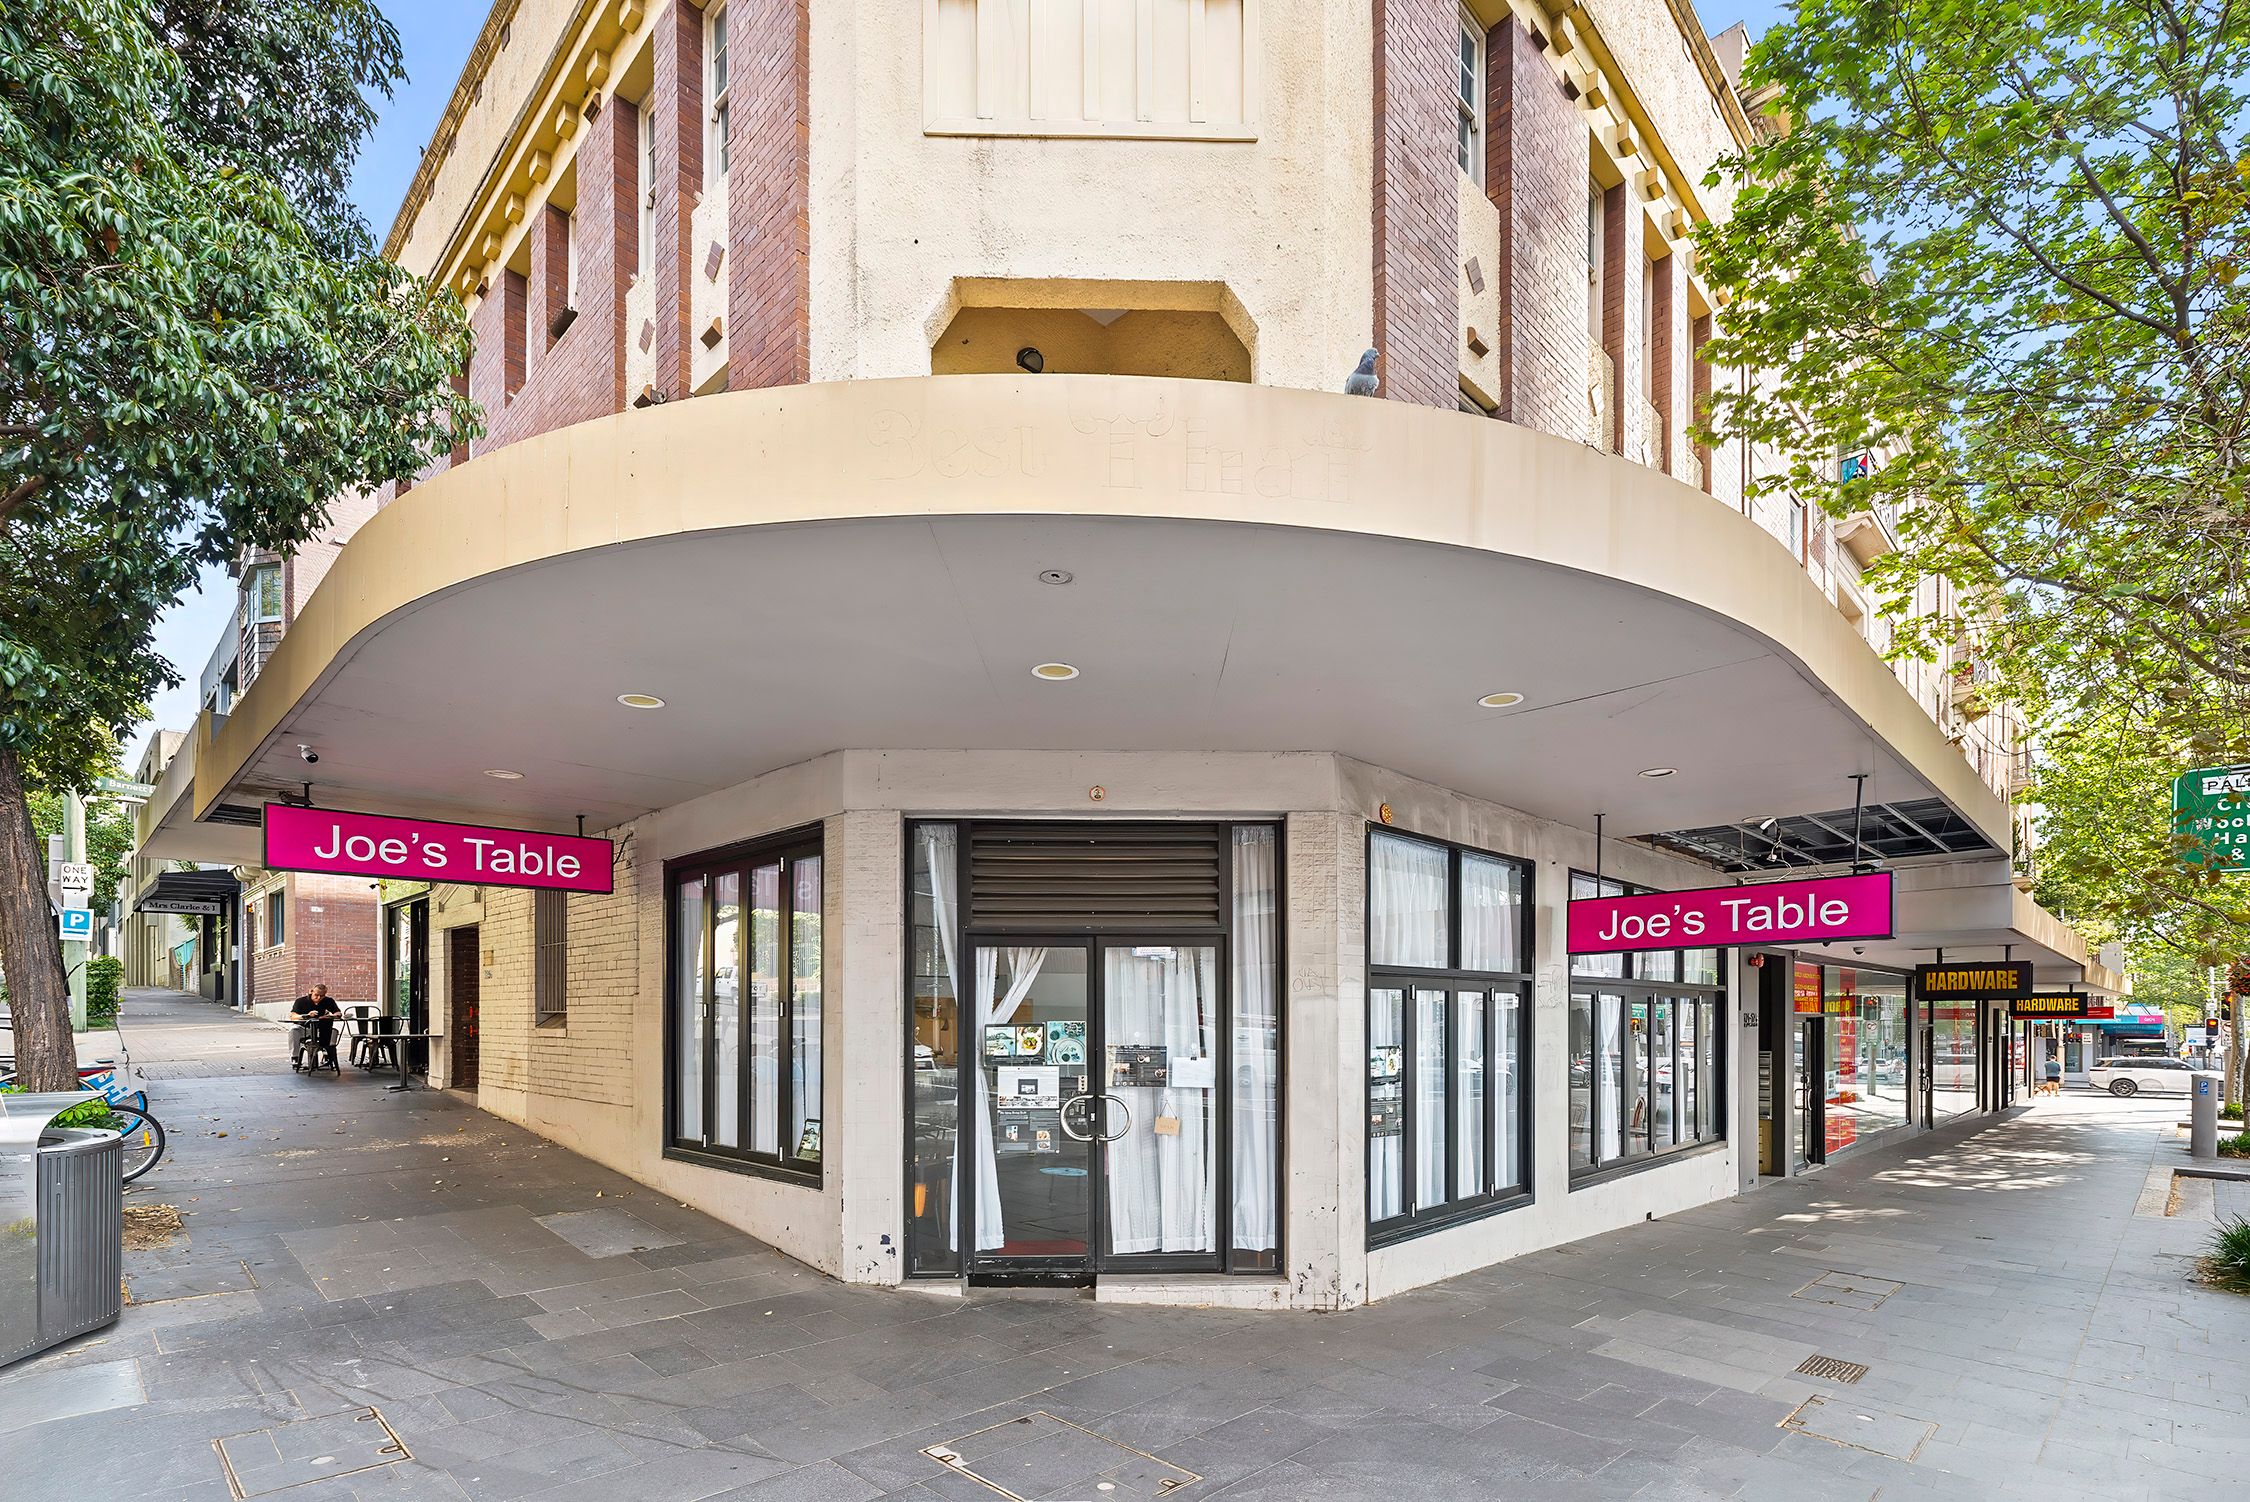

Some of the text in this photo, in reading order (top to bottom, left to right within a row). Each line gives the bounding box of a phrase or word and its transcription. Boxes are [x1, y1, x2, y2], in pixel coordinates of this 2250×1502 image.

[463, 837, 581, 878] Table
[63, 866, 87, 874] ONE
[62, 876, 88, 884] WAY
[70, 913, 84, 926] P
[1720, 893, 1849, 932] Table
[1925, 969, 2018, 992] HARDWARE
[2016, 997, 2080, 1012] HARDWARE
